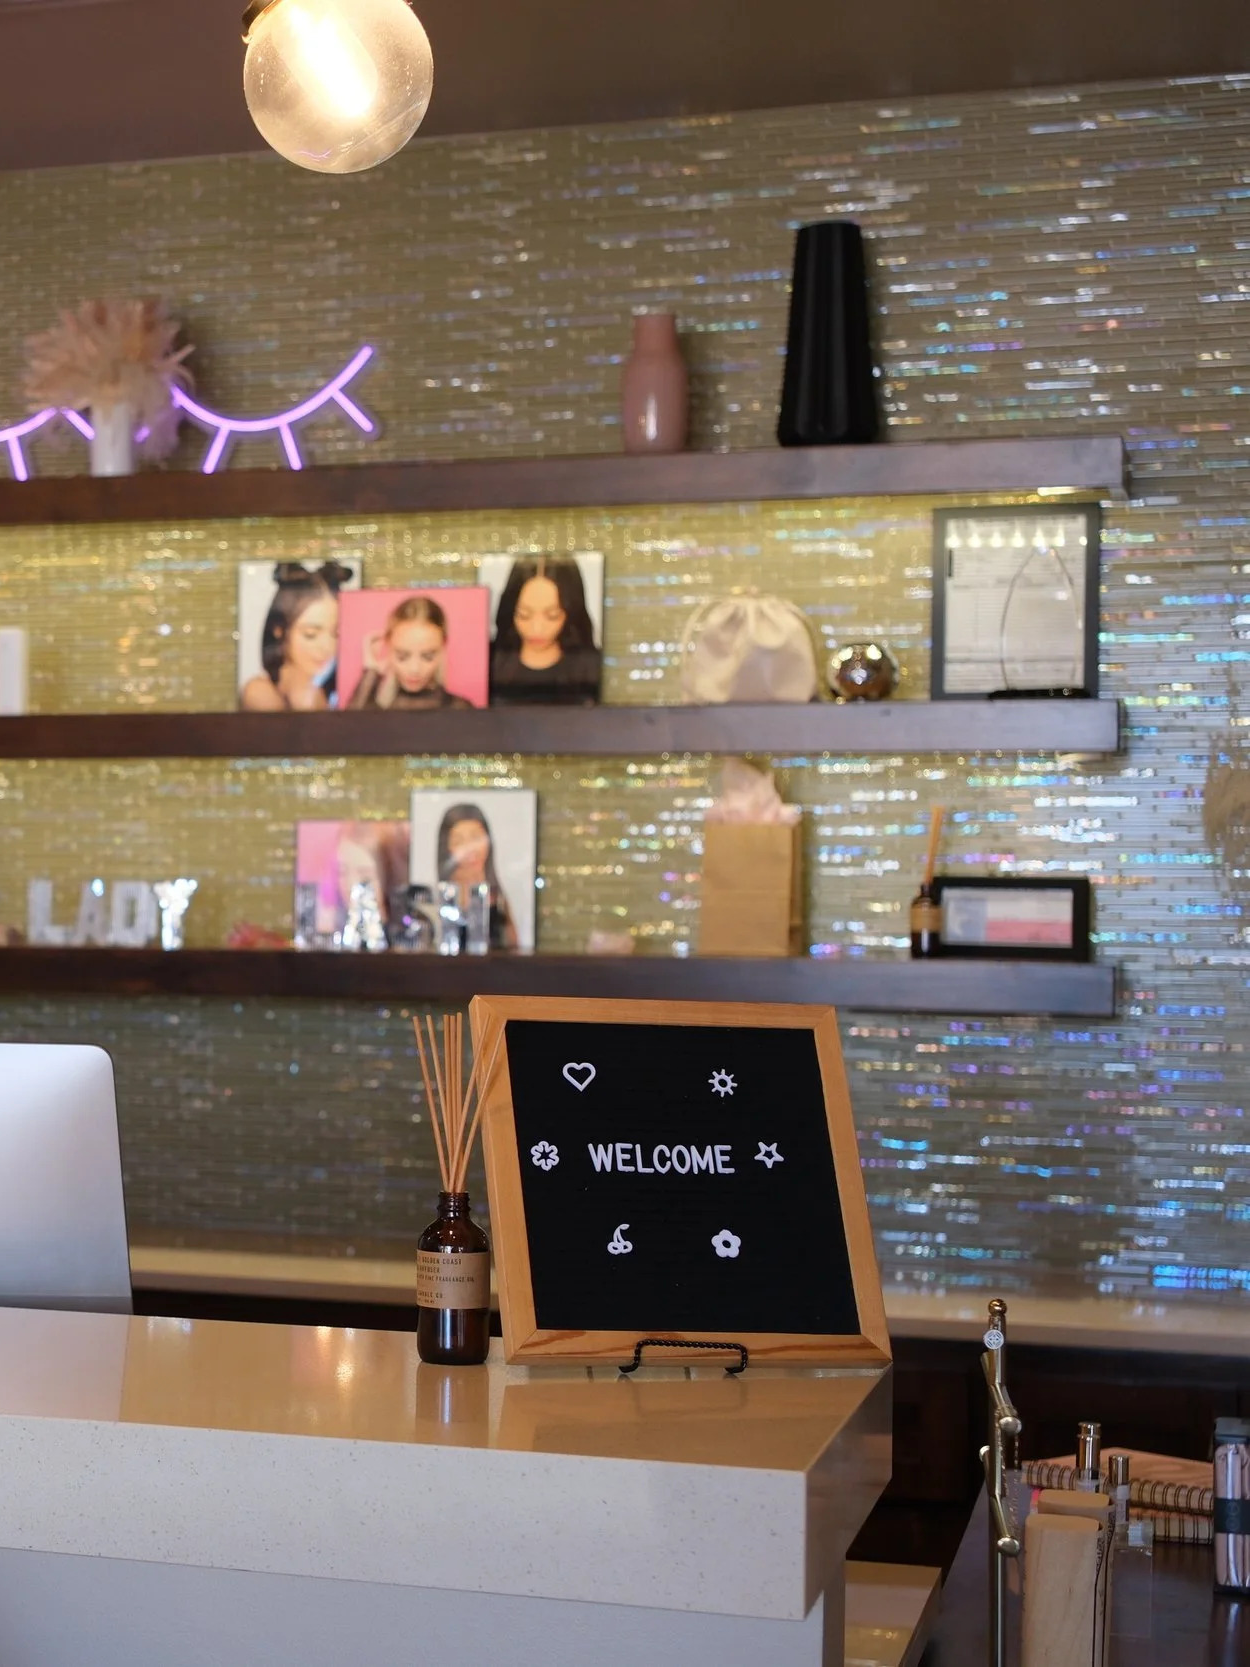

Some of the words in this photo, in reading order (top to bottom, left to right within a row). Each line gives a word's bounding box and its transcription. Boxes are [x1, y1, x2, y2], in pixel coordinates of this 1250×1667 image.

[27, 877, 198, 951] LADY
[292, 880, 491, 957] LASH
[588, 1142, 735, 1174] WELCOME
